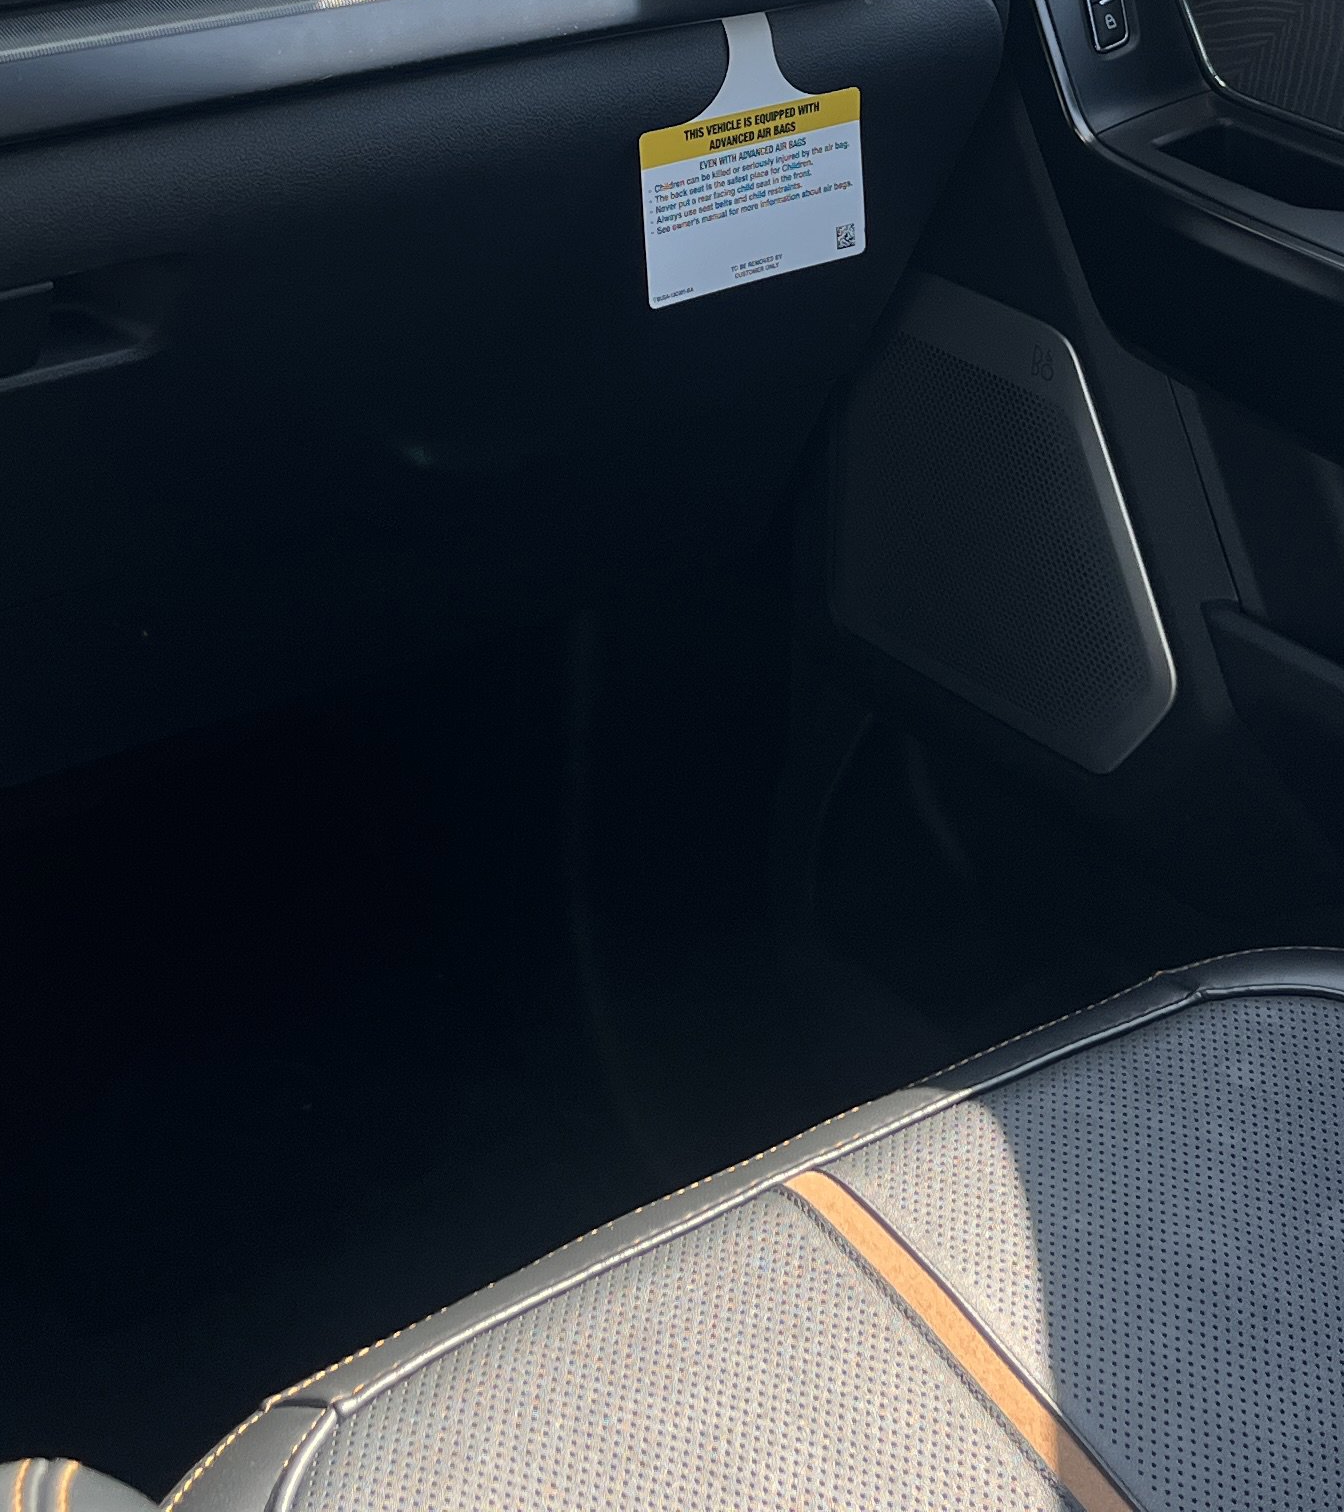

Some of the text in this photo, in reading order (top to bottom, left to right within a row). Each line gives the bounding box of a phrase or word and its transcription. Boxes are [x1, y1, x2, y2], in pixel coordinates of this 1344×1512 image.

[684, 101, 820, 141] THIS VEHICLE IS EQUIPPED WITH
[709, 122, 796, 151] ADVANCED AIR BAGS
[654, 179, 685, 193] Children
[686, 176, 699, 185] can
[701, 173, 711, 182] be
[712, 167, 731, 179] killed
[742, 156, 775, 171] seriously
[776, 150, 800, 164] injured
[801, 148, 810, 157] by
[812, 146, 823, 155] the
[824, 143, 833, 152] air
[699, 137, 807, 171] EVEN WITH ADVANCED AIR BAGS
[655, 194, 668, 203] The
[670, 190, 688, 200] back
[689, 185, 704, 195] seat
[714, 180, 725, 189] the
[727, 174, 748, 186] safest
[750, 170, 769, 181] place
[771, 166, 780, 175] for
[656, 203, 677, 214] Never
[678, 199, 691, 209] put
[698, 194, 712, 203] rear
[713, 188, 736, 200] facing
[737, 183, 755, 193] child
[756, 179, 771, 188] seat
[772, 176, 780, 184] in
[780, 173, 792, 182] the
[656, 214, 682, 225] Always
[683, 209, 697, 218] use
[698, 204, 714, 213] seat
[714, 199, 733, 209] belts
[734, 195, 747, 205] and
[748, 190, 766, 200] child
[656, 225, 671, 235] See
[701, 210, 728, 222] manual
[729, 206, 739, 216] for
[741, 204, 758, 213] more
[760, 192, 800, 208] information
[802, 187, 822, 198] about
[823, 184, 832, 192] air
